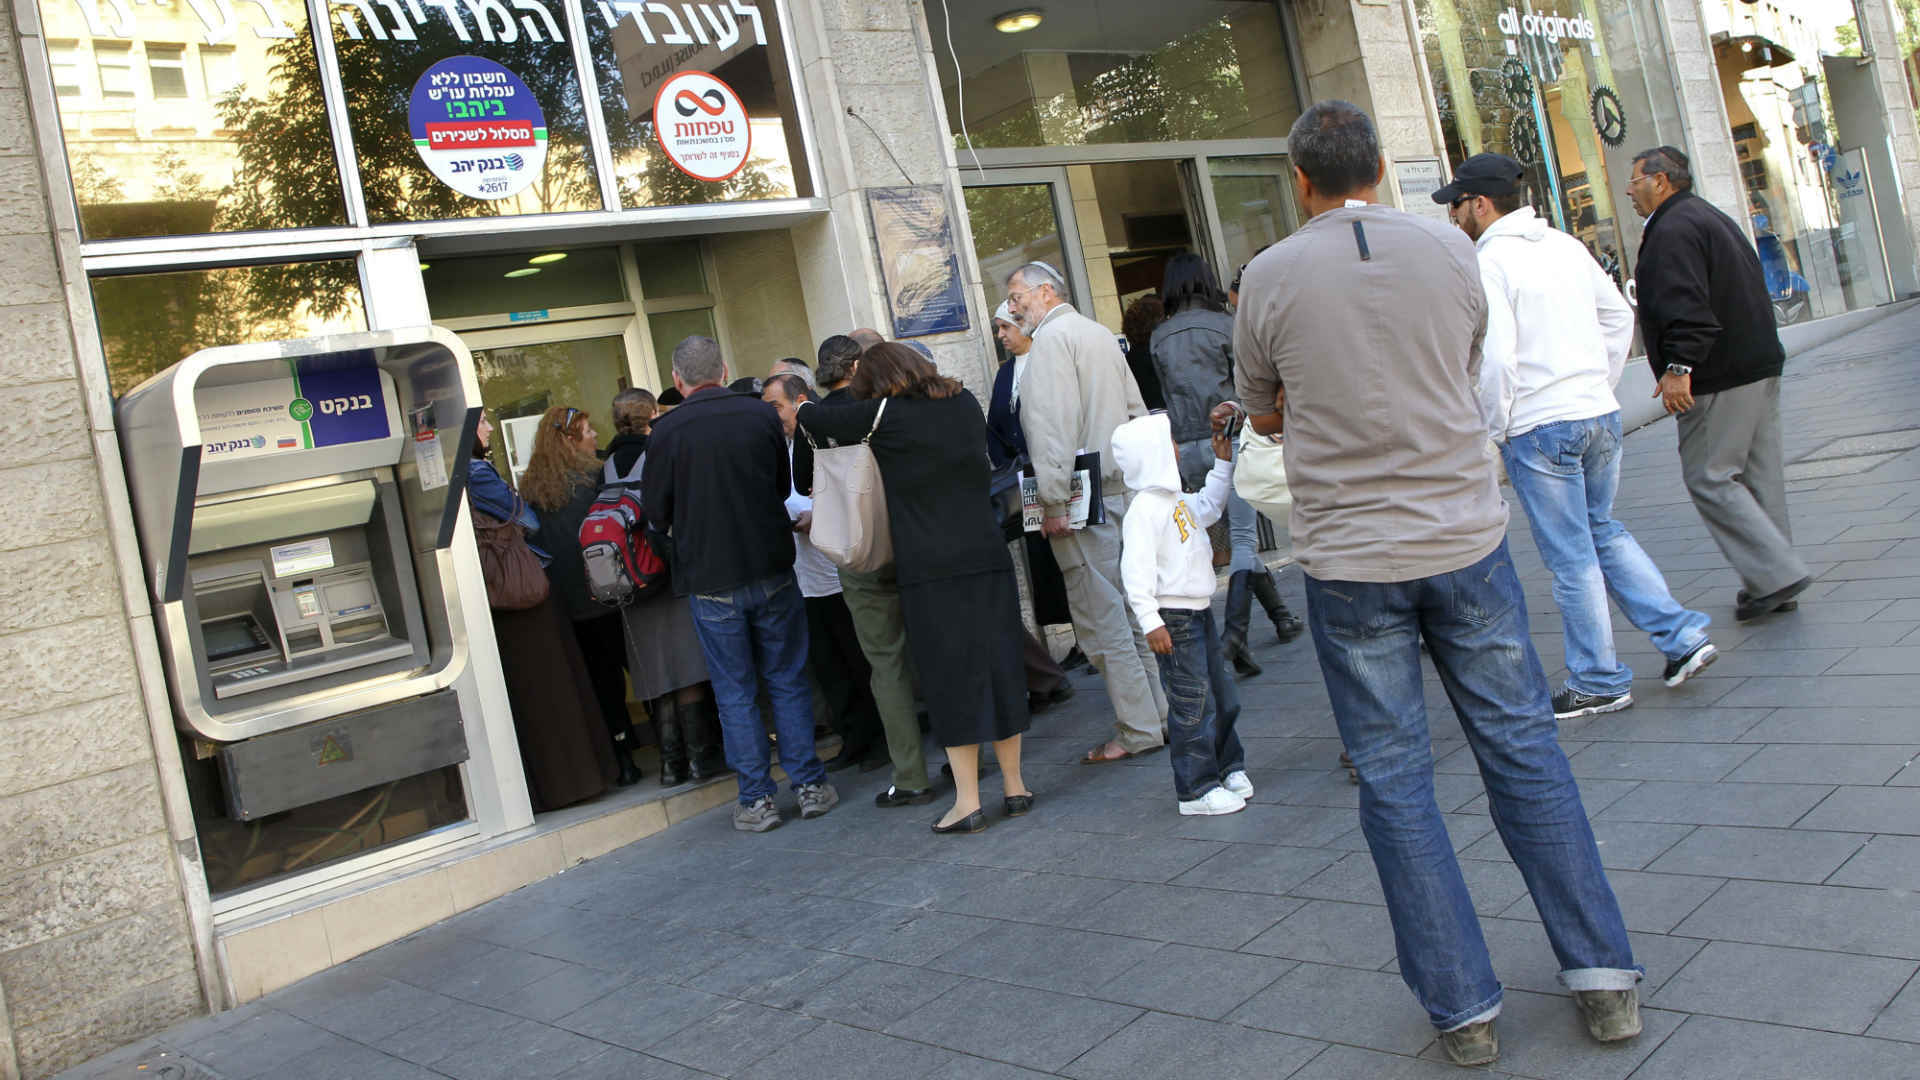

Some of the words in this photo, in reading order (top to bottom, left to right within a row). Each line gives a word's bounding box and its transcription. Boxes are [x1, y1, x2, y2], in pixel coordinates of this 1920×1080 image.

[333, 0, 565, 43] המדינה
[598, 0, 767, 51] לעובדי
[1498, 7, 1520, 35] all
[1522, 10, 1595, 43] originals
[430, 72, 460, 86] ללא
[463, 72, 507, 87] חשבון
[428, 87, 466, 100] עו"ש
[469, 85, 515, 99] עמלות
[446, 99, 507, 119] ביהב!
[431, 128, 487, 143] לשכירים
[488, 127, 531, 141] מסלול
[674, 120, 735, 137] טפחות
[449, 161, 475, 173] יהב
[477, 158, 504, 173] בנק
[320, 394, 373, 416] בנקט
[207, 442, 226, 453] יהב
[228, 437, 250, 452] בנק
